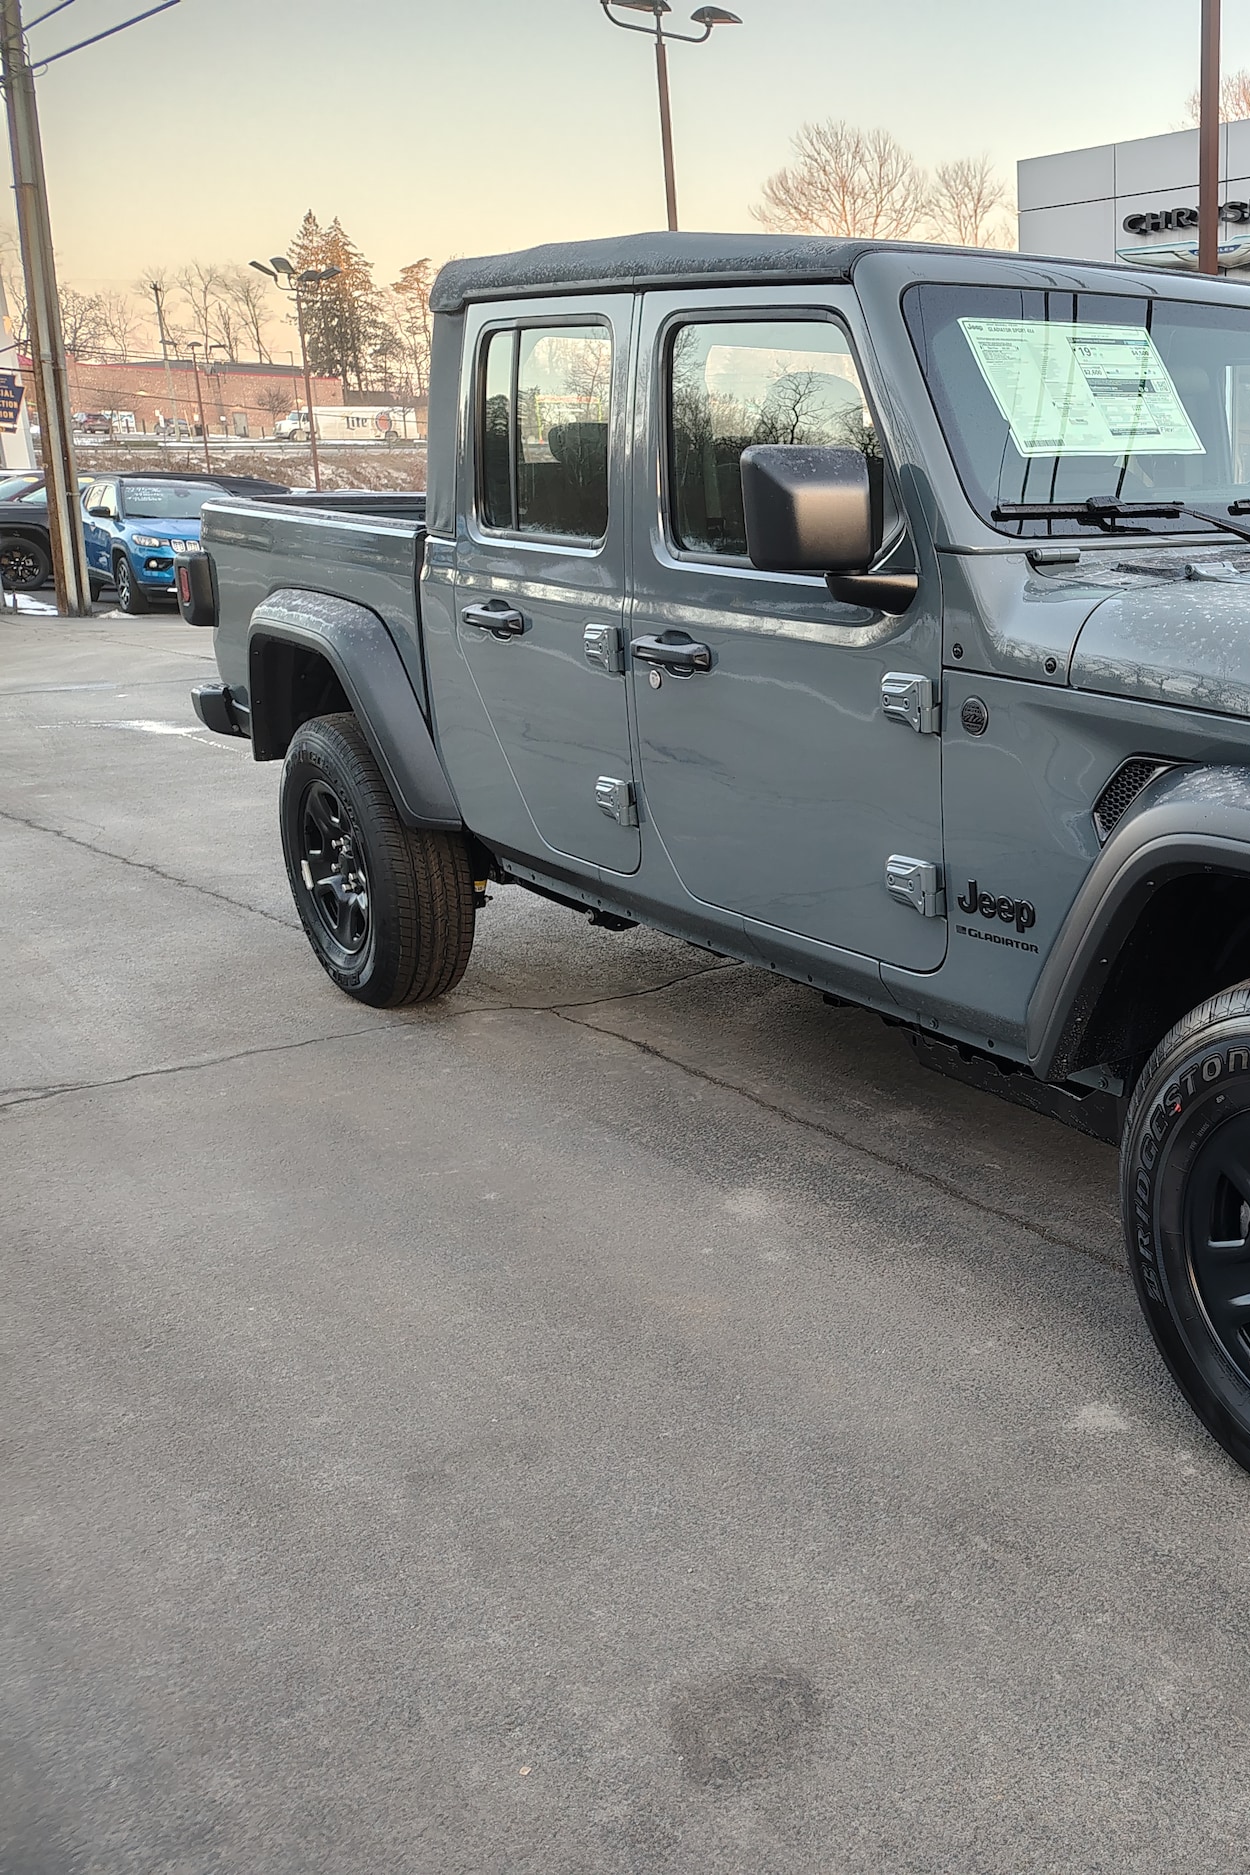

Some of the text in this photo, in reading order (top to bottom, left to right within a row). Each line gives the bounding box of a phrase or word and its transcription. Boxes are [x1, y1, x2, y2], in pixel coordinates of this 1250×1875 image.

[1078, 347, 1092, 357] 19
[0, 389, 15, 398] IAL
[0, 400, 19, 409] TION
[346, 416, 368, 430] Lite
[957, 878, 1036, 934] Jeep
[967, 928, 1040, 955] GLADIATOR
